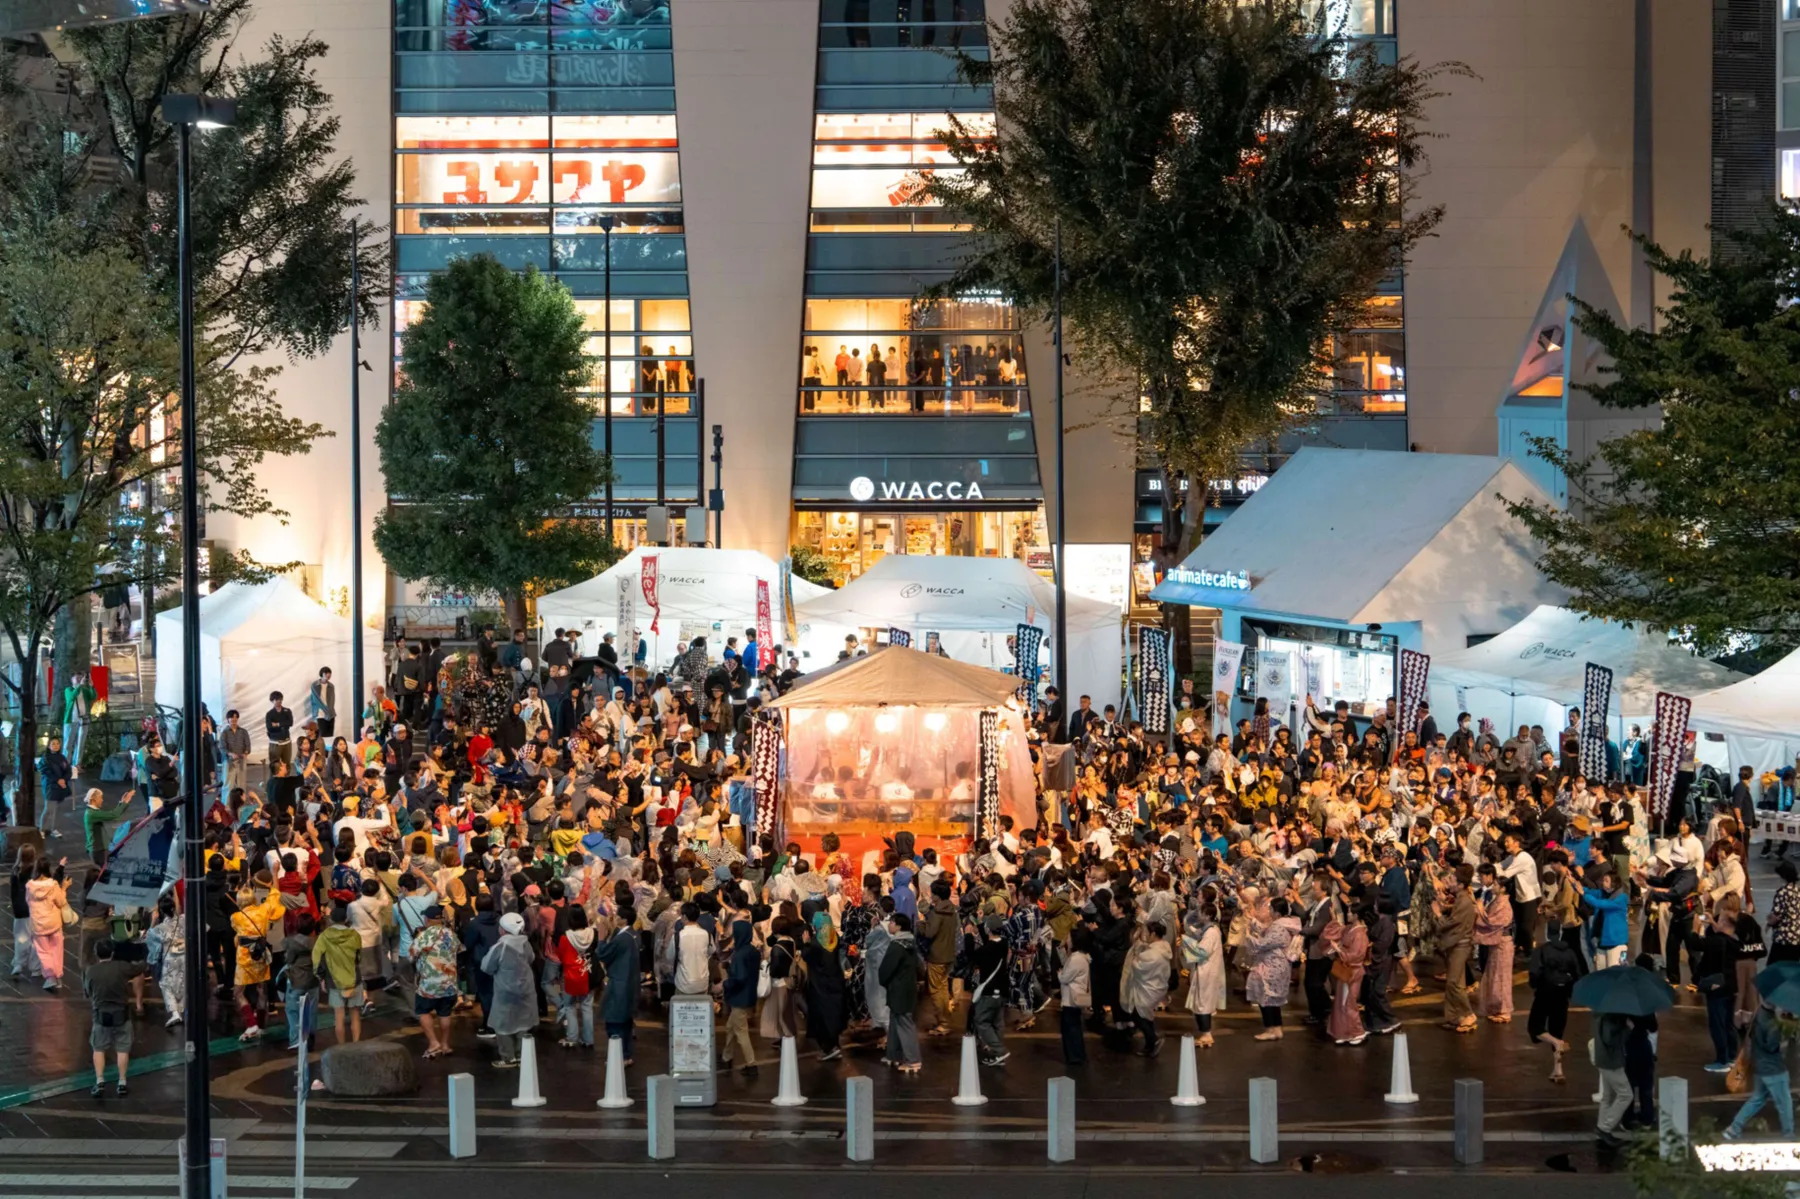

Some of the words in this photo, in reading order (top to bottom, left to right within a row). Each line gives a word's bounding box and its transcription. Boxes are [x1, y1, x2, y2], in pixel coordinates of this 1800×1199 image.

[881, 481, 983, 499] WACCA
[669, 576, 705, 584] WACCA
[926, 587, 965, 595] WACCA
[1544, 647, 1577, 658] WACCA
